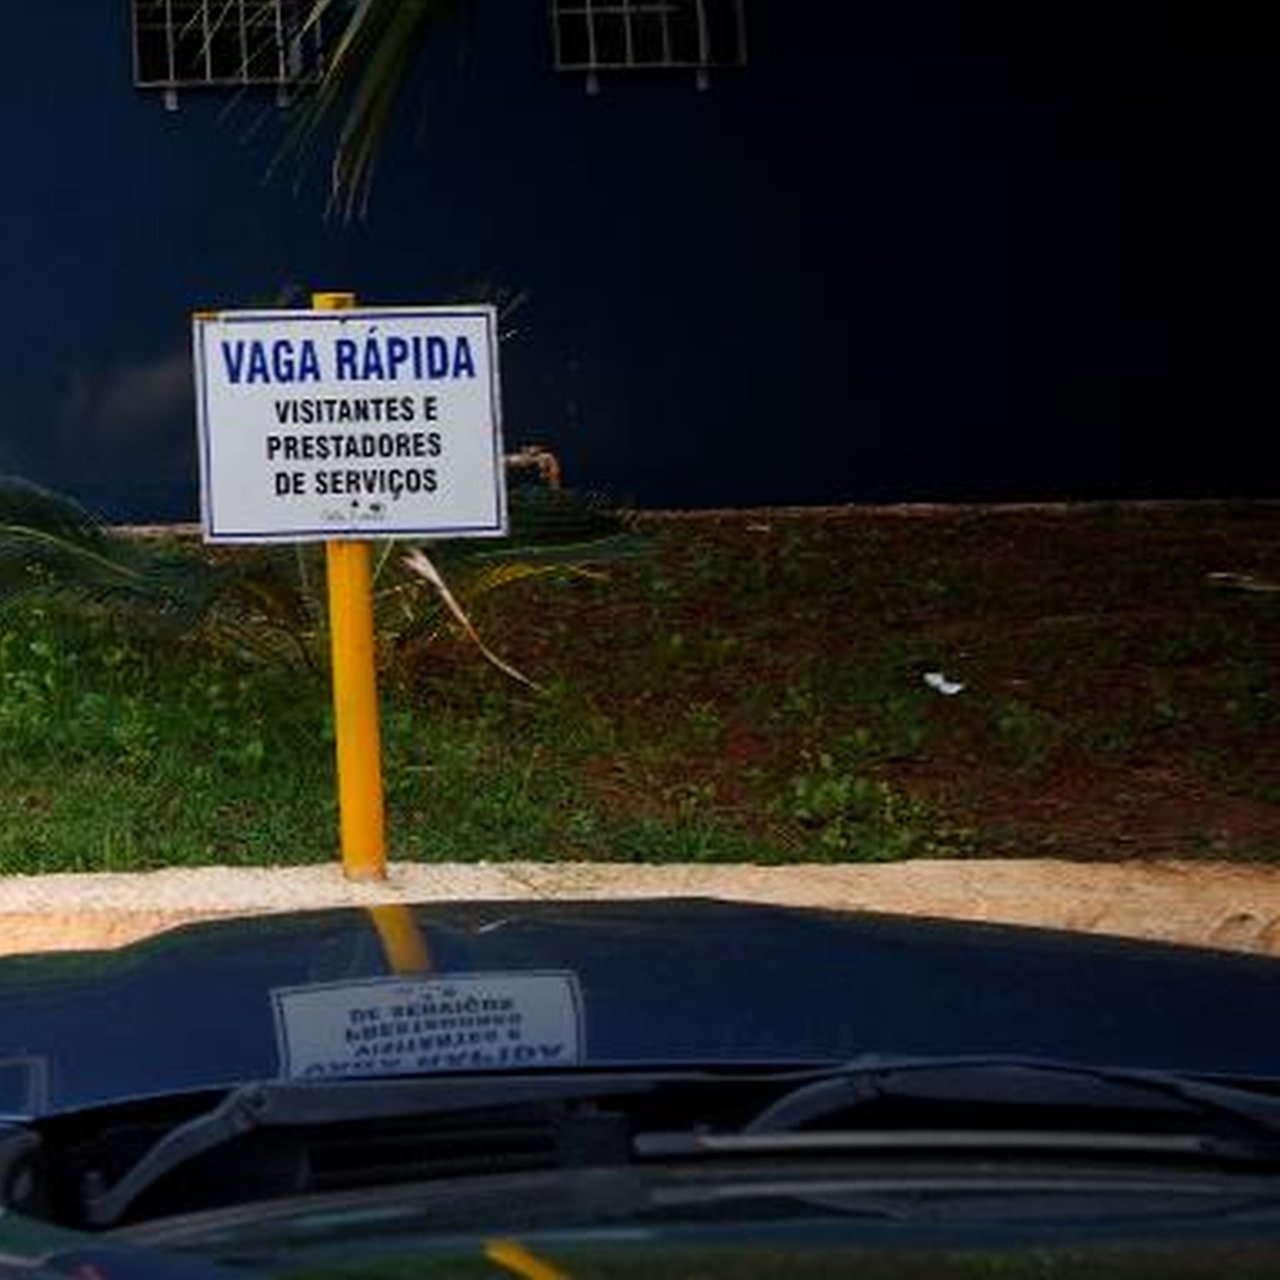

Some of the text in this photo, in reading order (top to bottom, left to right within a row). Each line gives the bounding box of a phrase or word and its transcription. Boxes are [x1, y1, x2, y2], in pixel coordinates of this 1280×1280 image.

[222, 326, 476, 384] VAGA RÁPIDA
[275, 396, 437, 424] VISITANTES E
[267, 433, 442, 460] PRESTADORES
[275, 469, 437, 500] DE SERVIÇOS
